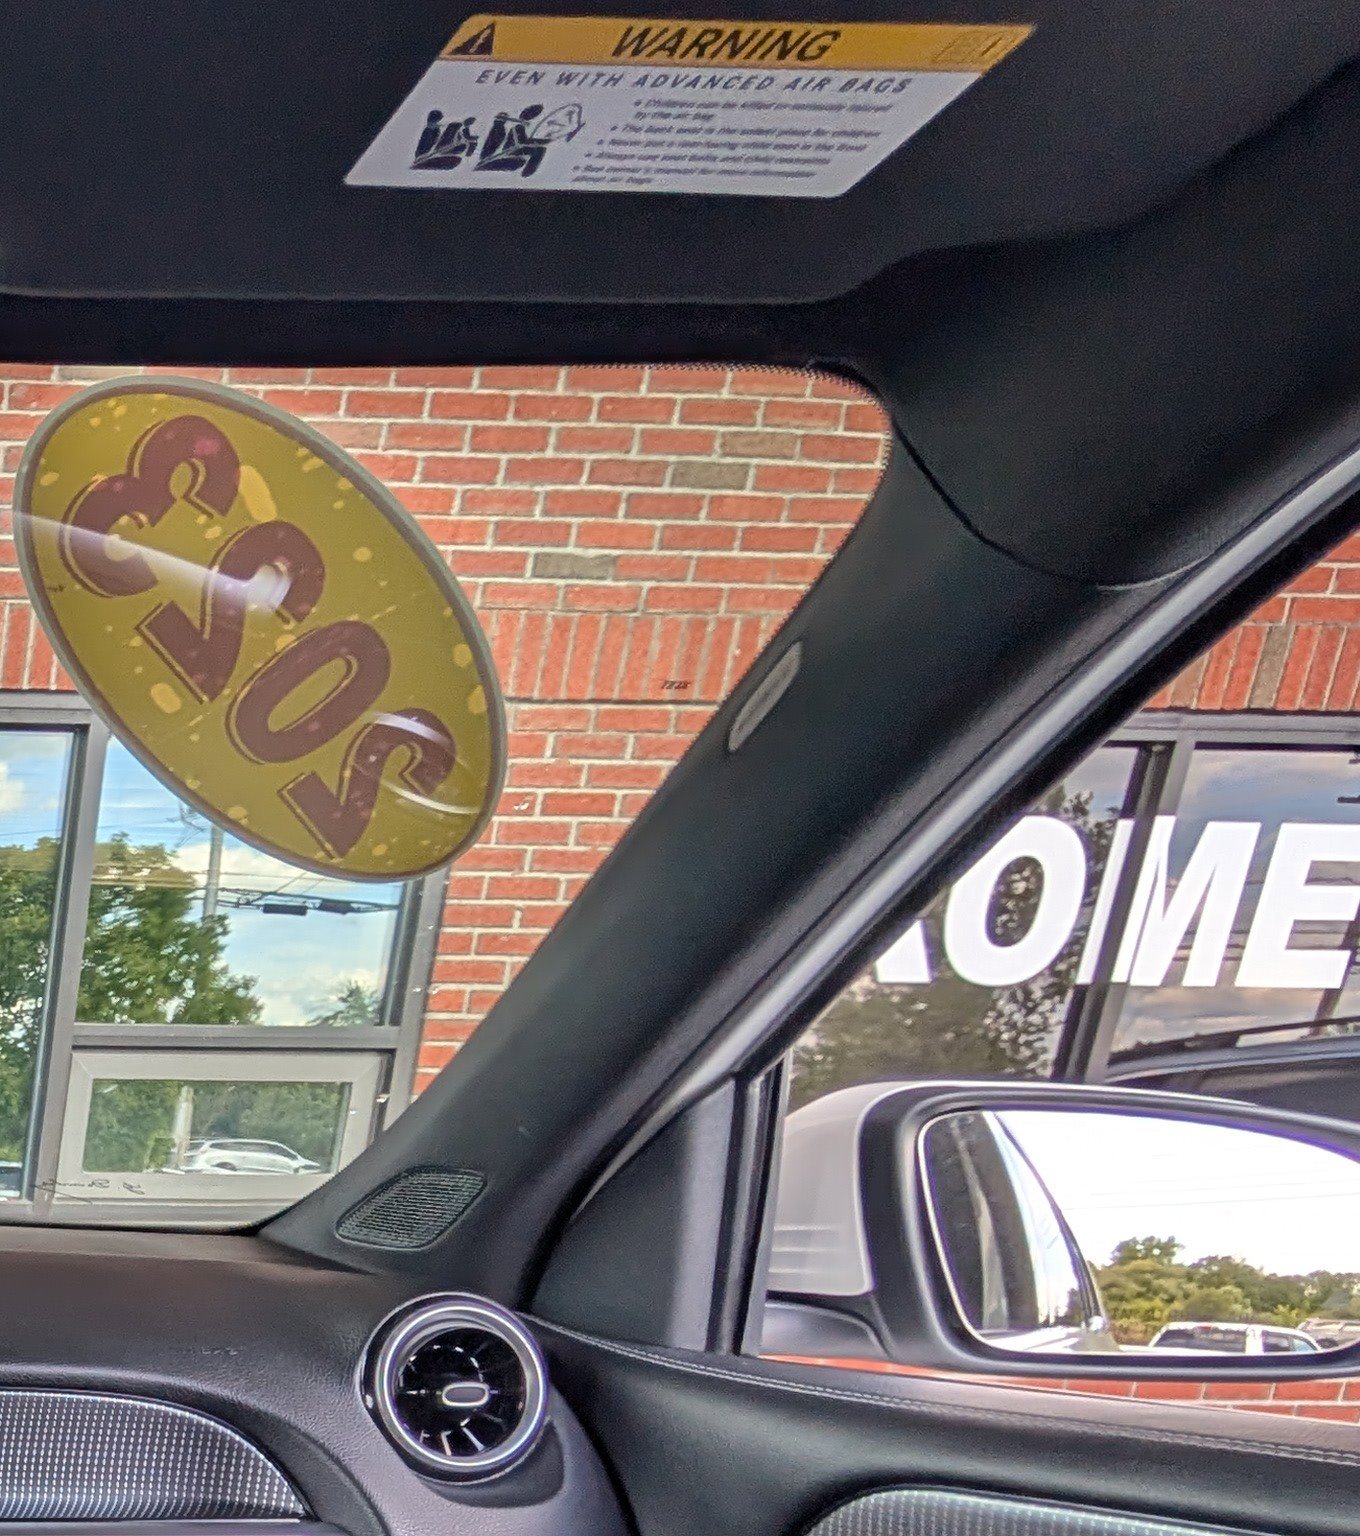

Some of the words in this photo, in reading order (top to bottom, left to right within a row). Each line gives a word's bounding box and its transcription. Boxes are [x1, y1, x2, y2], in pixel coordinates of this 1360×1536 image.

[611, 26, 842, 62] WARNING
[475, 69, 543, 85] EVEN
[556, 72, 621, 87] WITH
[635, 74, 775, 91] ADVANCED
[783, 77, 828, 93] AIR
[839, 78, 912, 94] BAGS
